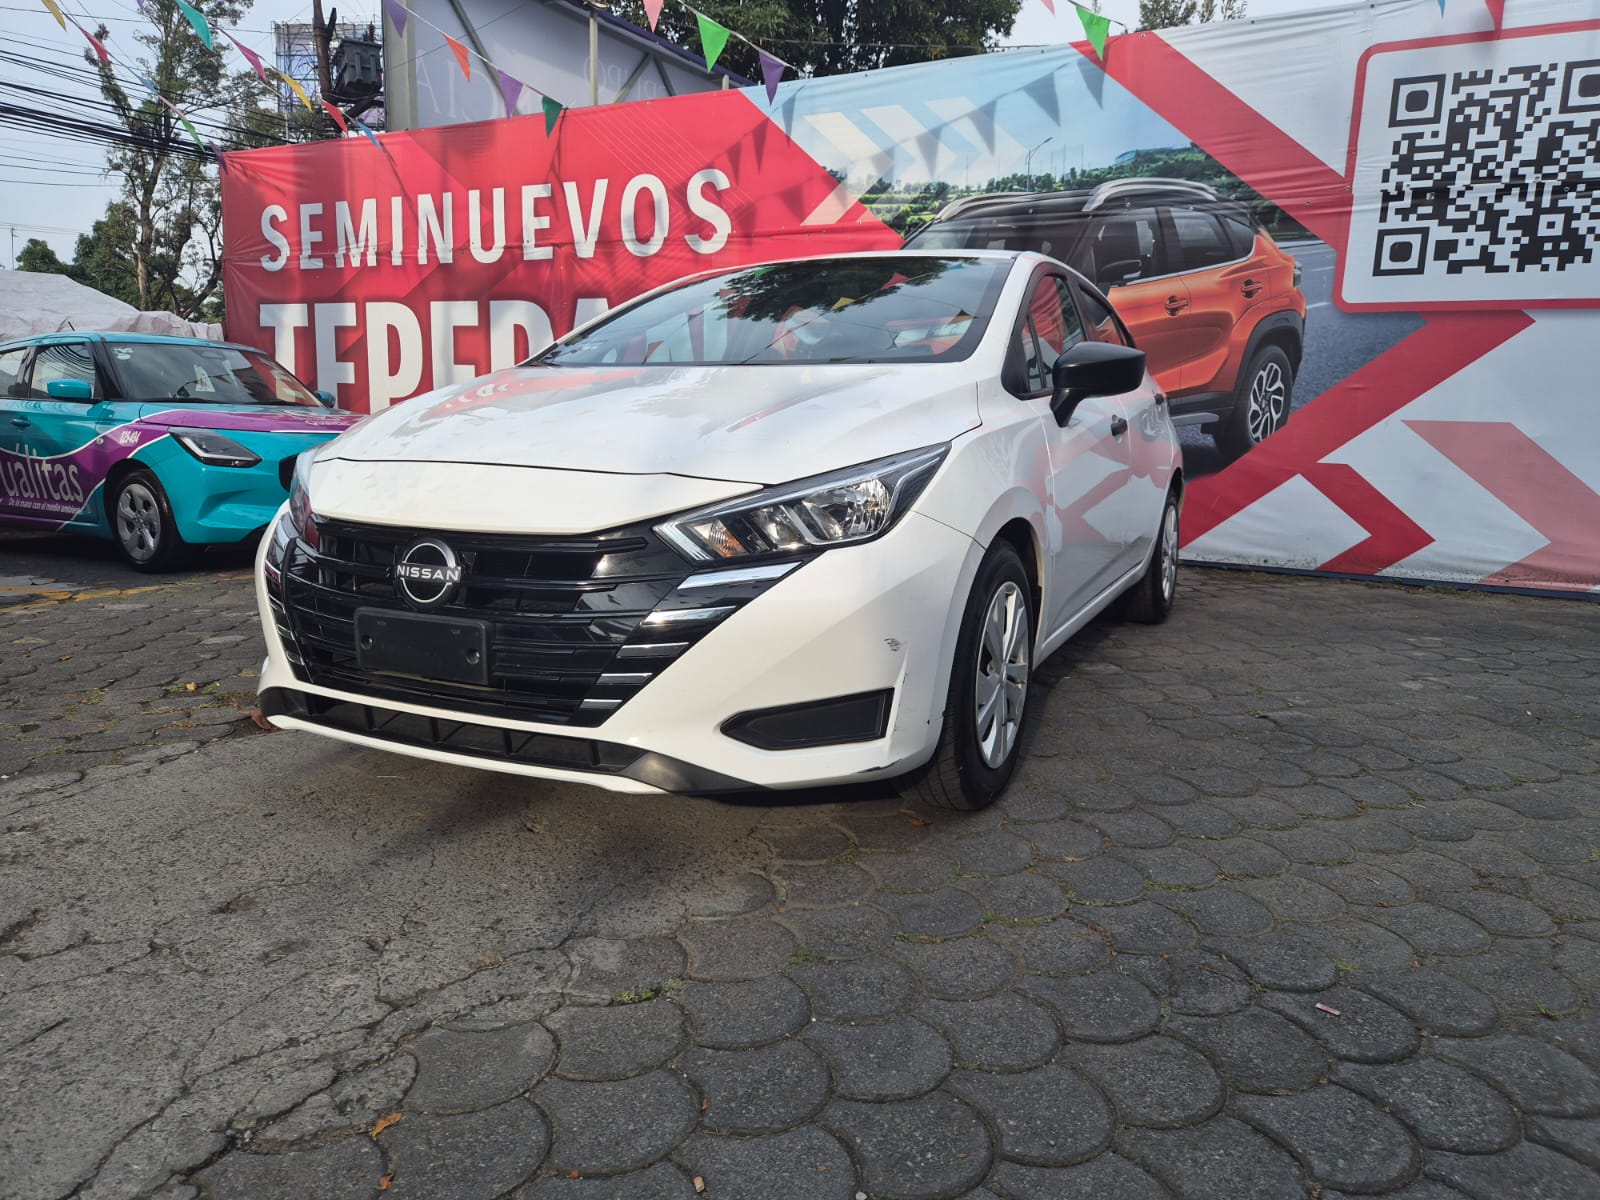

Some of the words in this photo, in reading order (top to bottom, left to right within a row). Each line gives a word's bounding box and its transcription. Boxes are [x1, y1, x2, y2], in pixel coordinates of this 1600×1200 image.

[260, 168, 732, 272] SEMINUEVOS
[0, 443, 84, 503] uálitas
[397, 565, 460, 581] NISSAN
